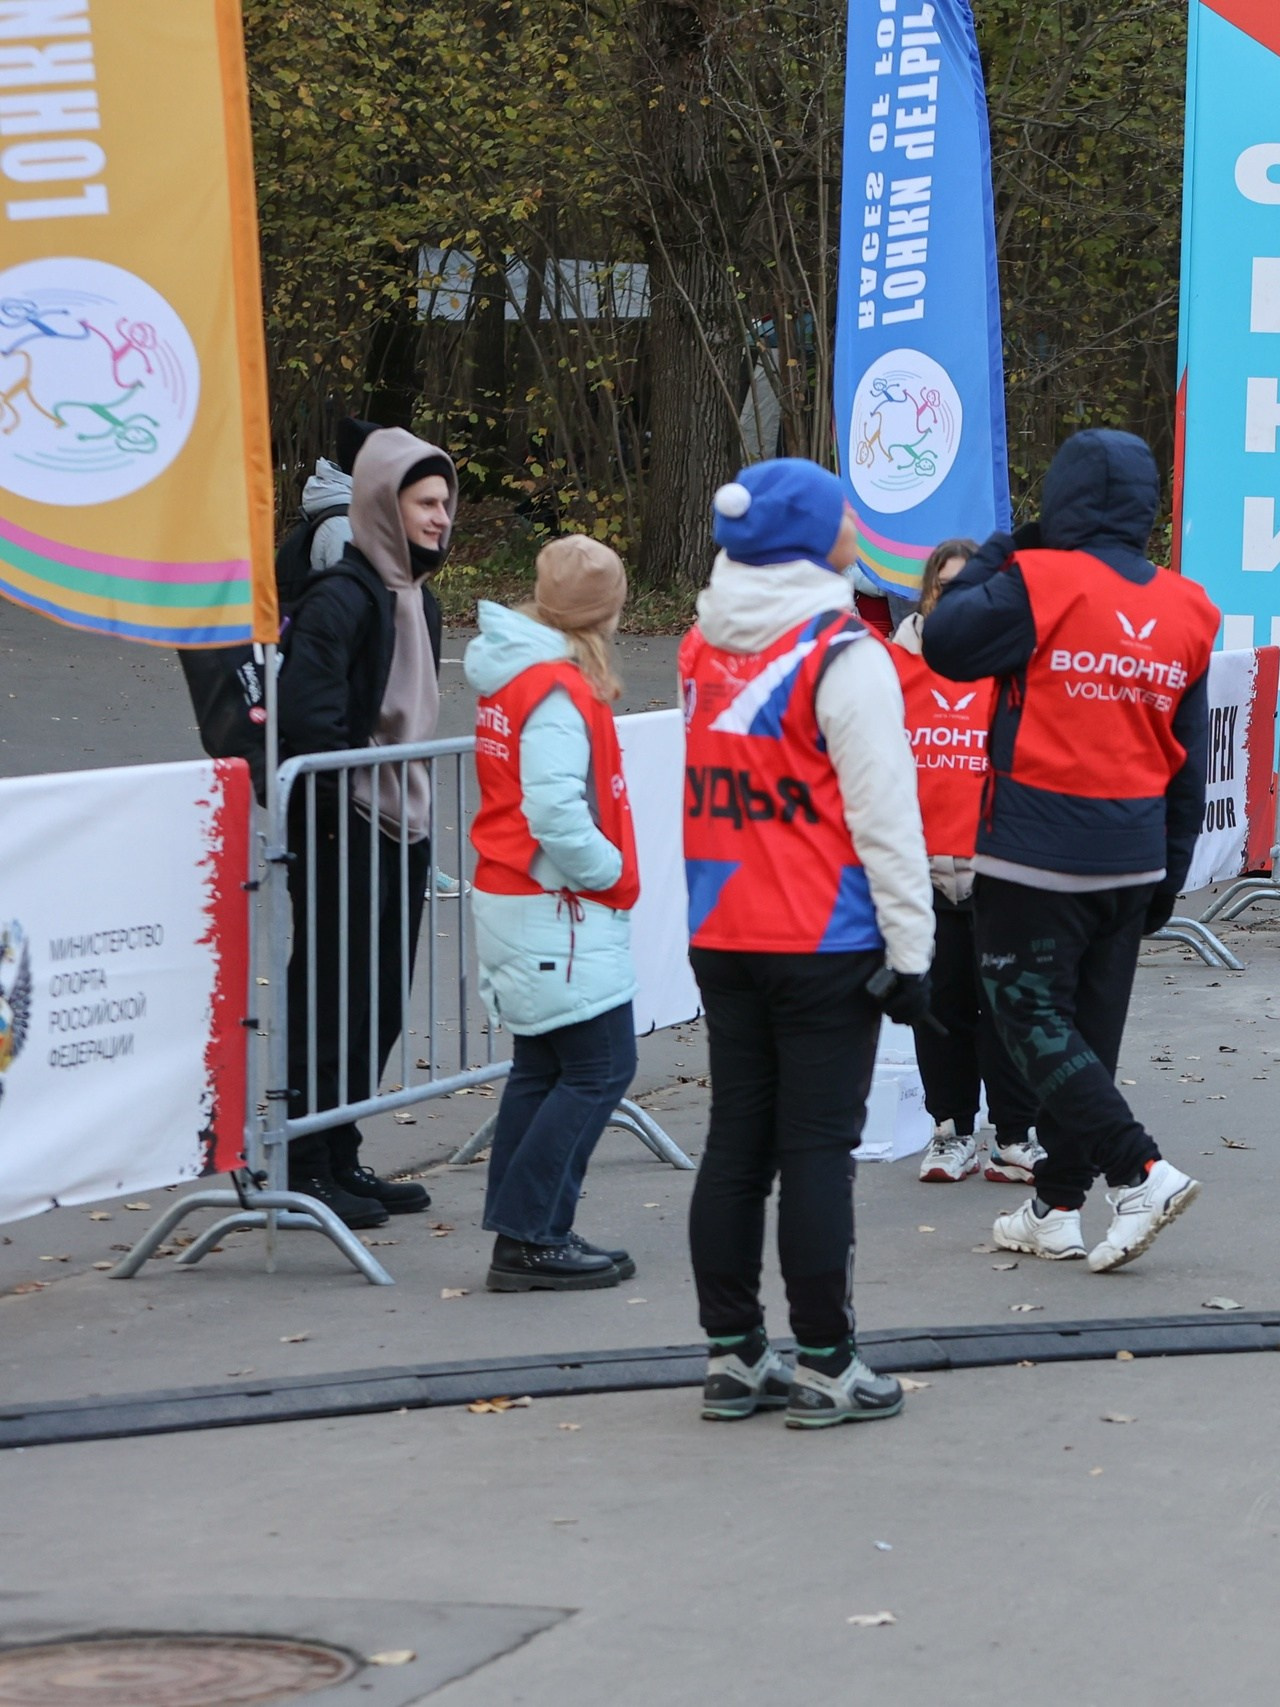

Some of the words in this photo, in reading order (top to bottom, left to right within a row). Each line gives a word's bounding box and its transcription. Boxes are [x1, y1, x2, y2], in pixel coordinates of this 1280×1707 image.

[686, 766, 820, 830] УДЬЯ
[1200, 797, 1237, 834] OUR
[50, 922, 164, 962] МИНИСТЕРСТВО
[50, 968, 107, 998] СПОРТА
[49, 991, 147, 1034] РОССИЙСКОЙ
[49, 1033, 135, 1071] ФЕДЕРАЦИИ
